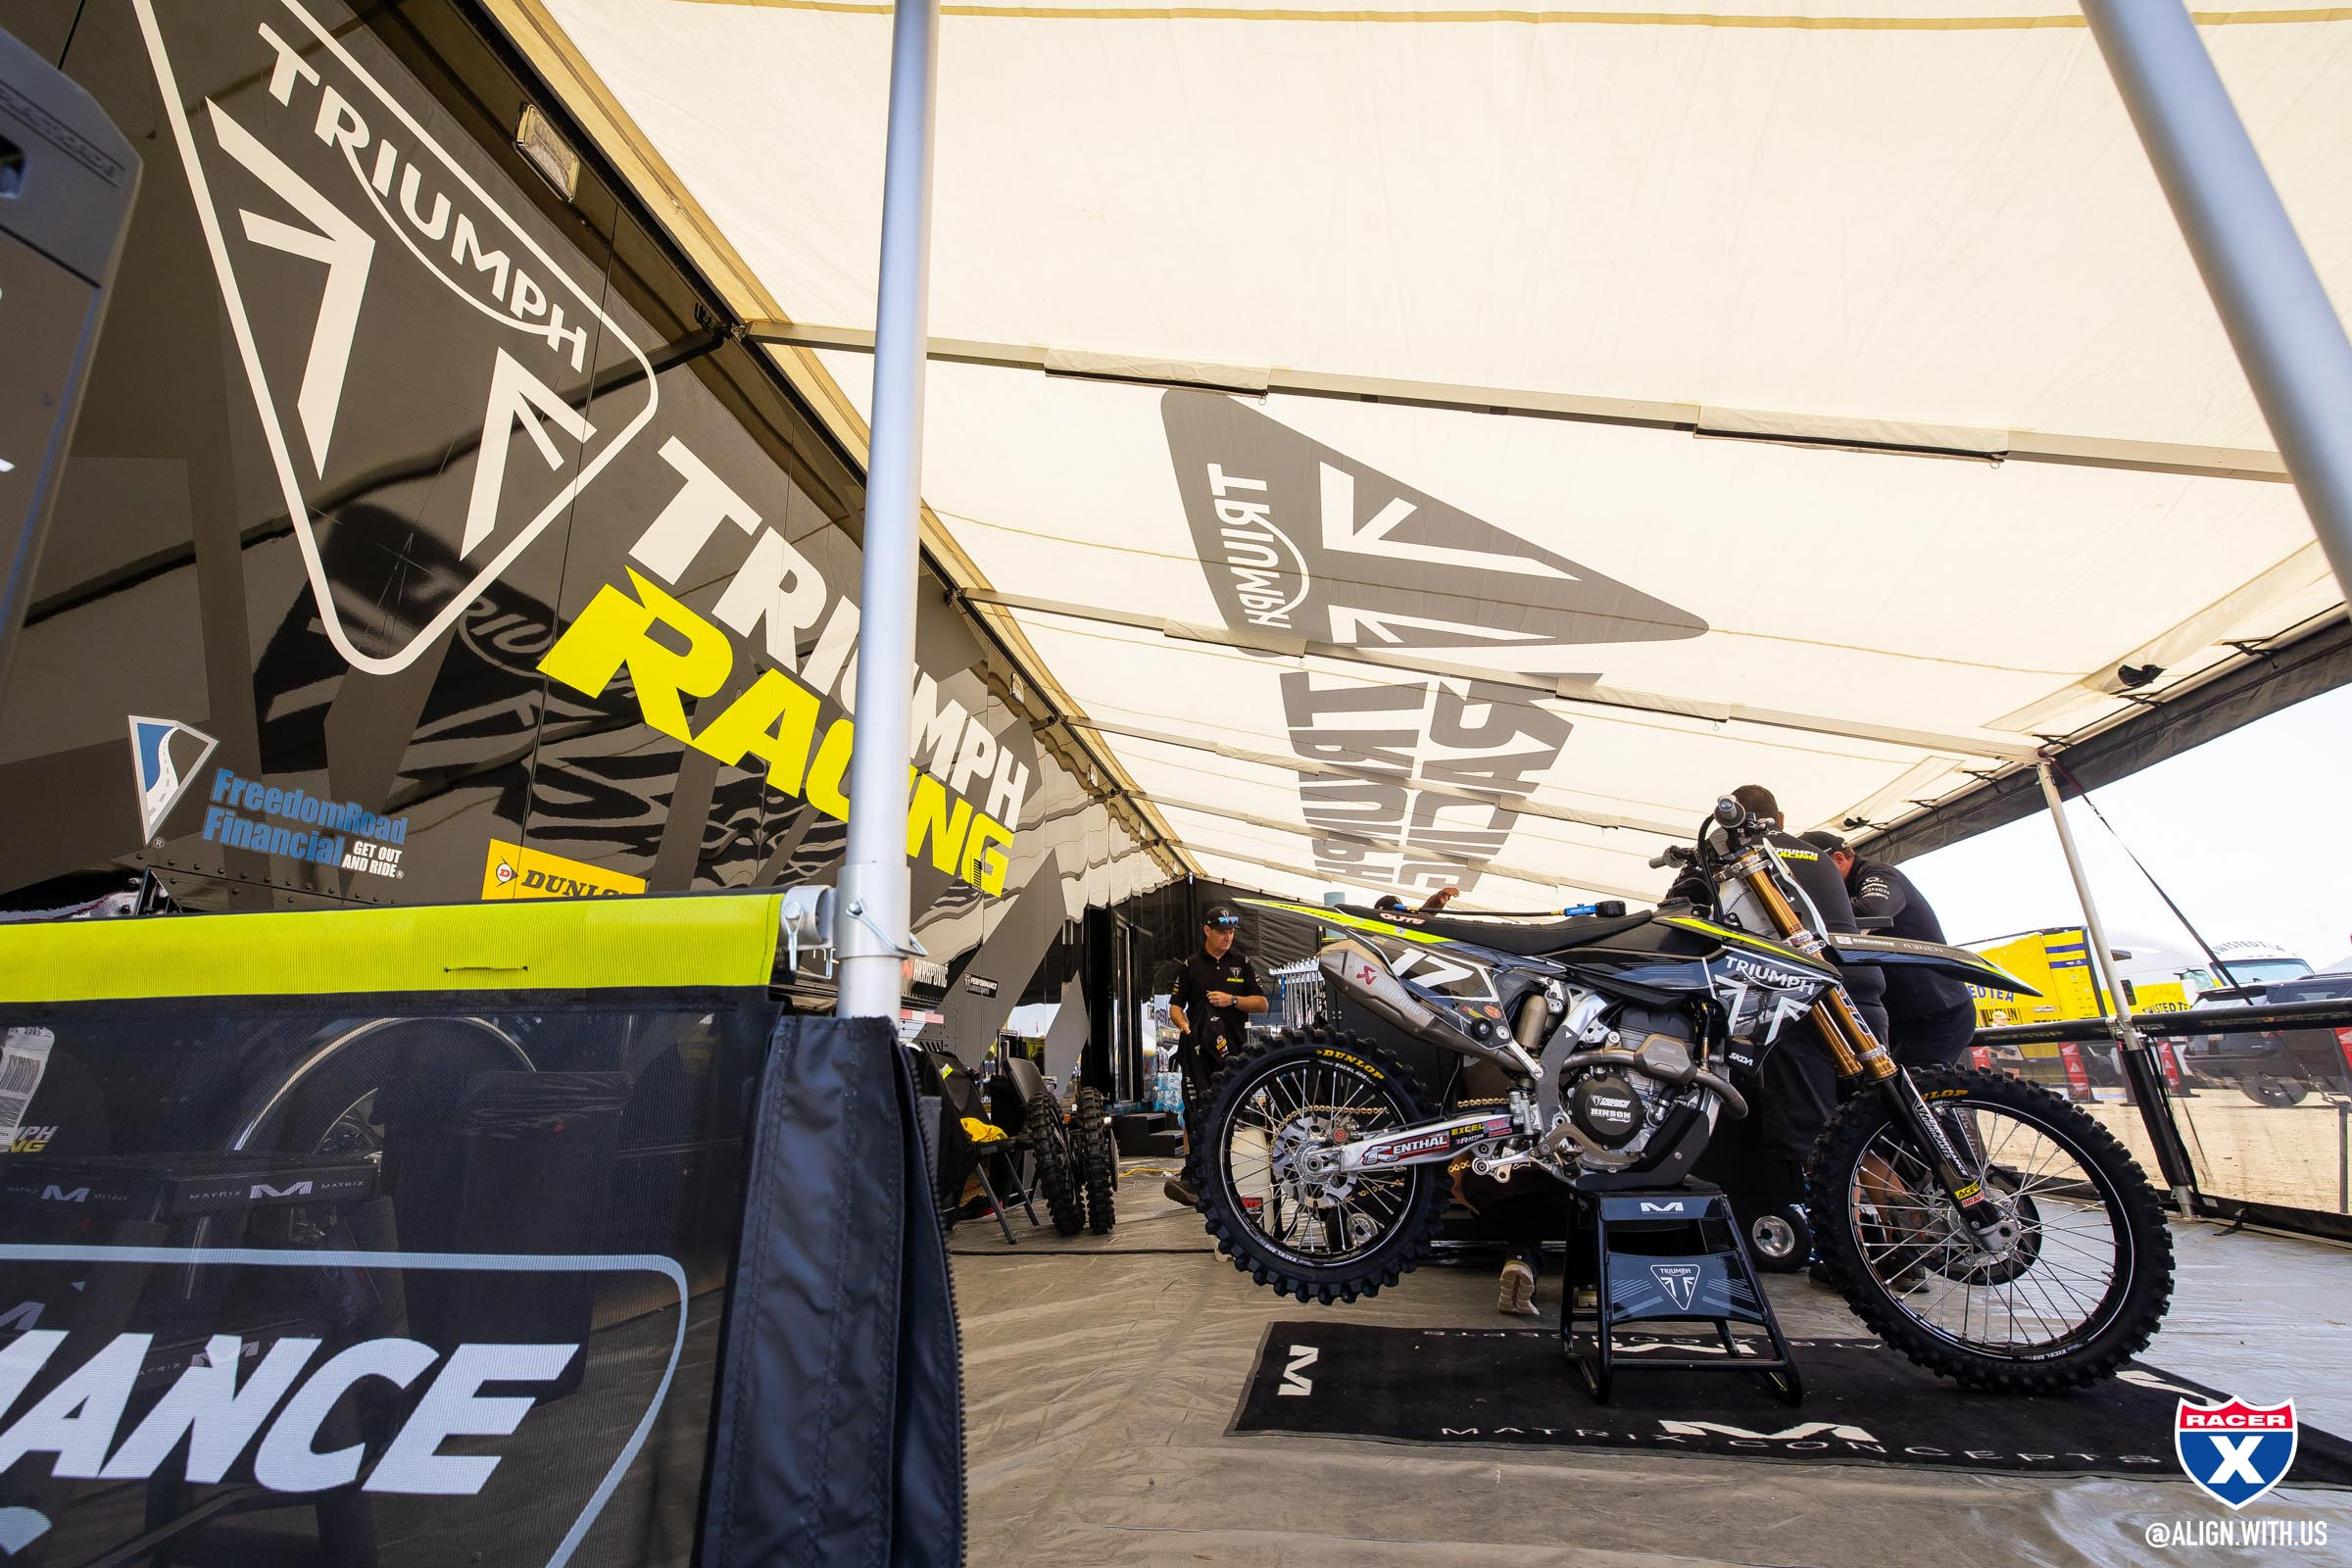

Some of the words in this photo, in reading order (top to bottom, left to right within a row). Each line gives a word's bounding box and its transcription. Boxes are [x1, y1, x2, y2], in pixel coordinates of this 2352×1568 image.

[258, 22, 588, 373] TRIUMPH
[628, 435, 1029, 832] TRIMPH
[536, 564, 1014, 898] RACNG
[203, 806, 345, 866] Financial
[354, 841, 377, 859] GET
[377, 846, 403, 864] OUT
[341, 854, 369, 873] AND
[1777, 852, 1819, 861] ACING
[1390, 947, 1475, 989] 17
[1725, 955, 1815, 996] TRIUMPH
[1322, 1049, 1385, 1080] DUNLOP
[1921, 1089, 1969, 1102] NLOP
[1451, 1122, 1485, 1136] EXCEL
[1441, 1426, 1687, 1444] MATRIX
[1728, 1439, 2162, 1464] CONCEPTS
